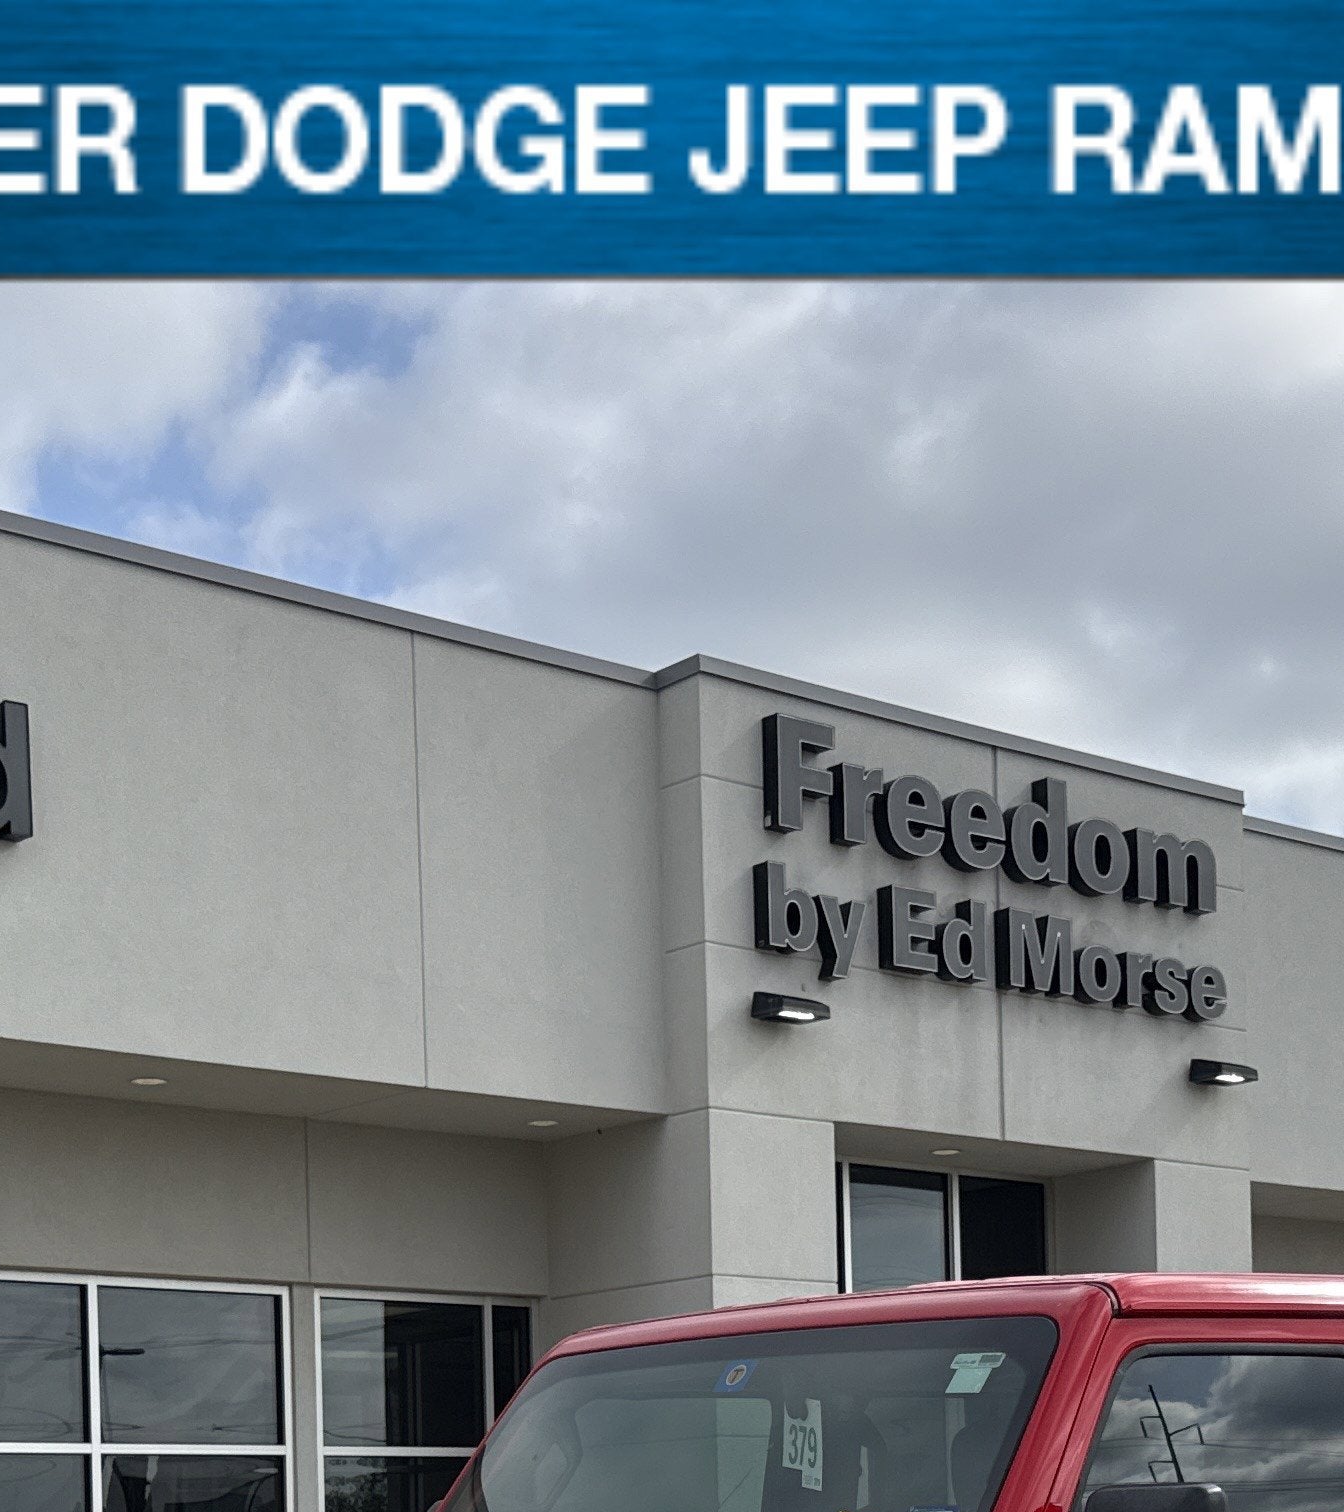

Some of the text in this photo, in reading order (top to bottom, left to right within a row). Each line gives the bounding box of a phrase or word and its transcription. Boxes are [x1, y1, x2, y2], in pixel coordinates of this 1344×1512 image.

[762, 713, 1218, 915] Freedom
[753, 860, 1228, 1023] by Ed Morse
[787, 1423, 818, 1468] 379
